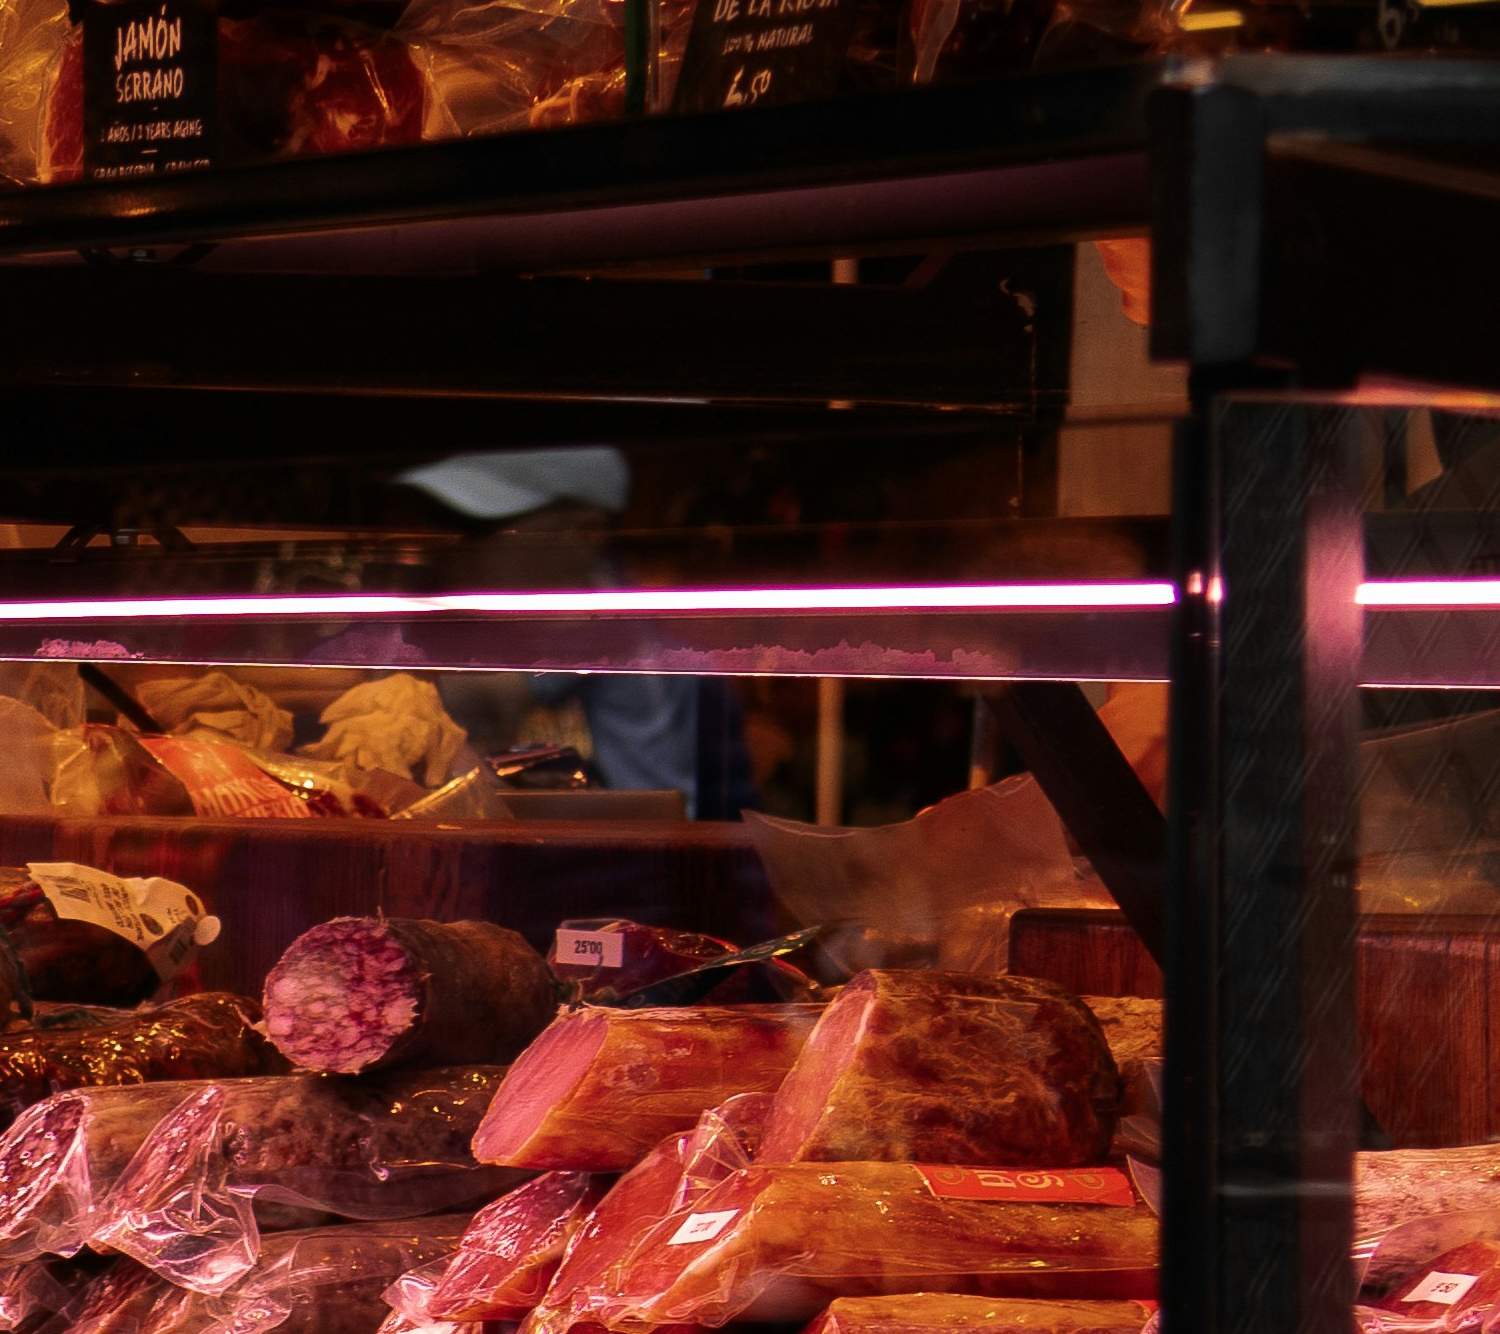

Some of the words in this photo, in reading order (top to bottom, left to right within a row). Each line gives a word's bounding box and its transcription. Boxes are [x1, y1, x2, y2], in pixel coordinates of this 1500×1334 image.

[114, 2, 182, 72] JAMÓN
[756, 23, 815, 52] NATURAL
[115, 67, 185, 104] SERRANO
[146, 119, 172, 140] YEARS
[173, 119, 204, 139] AGING
